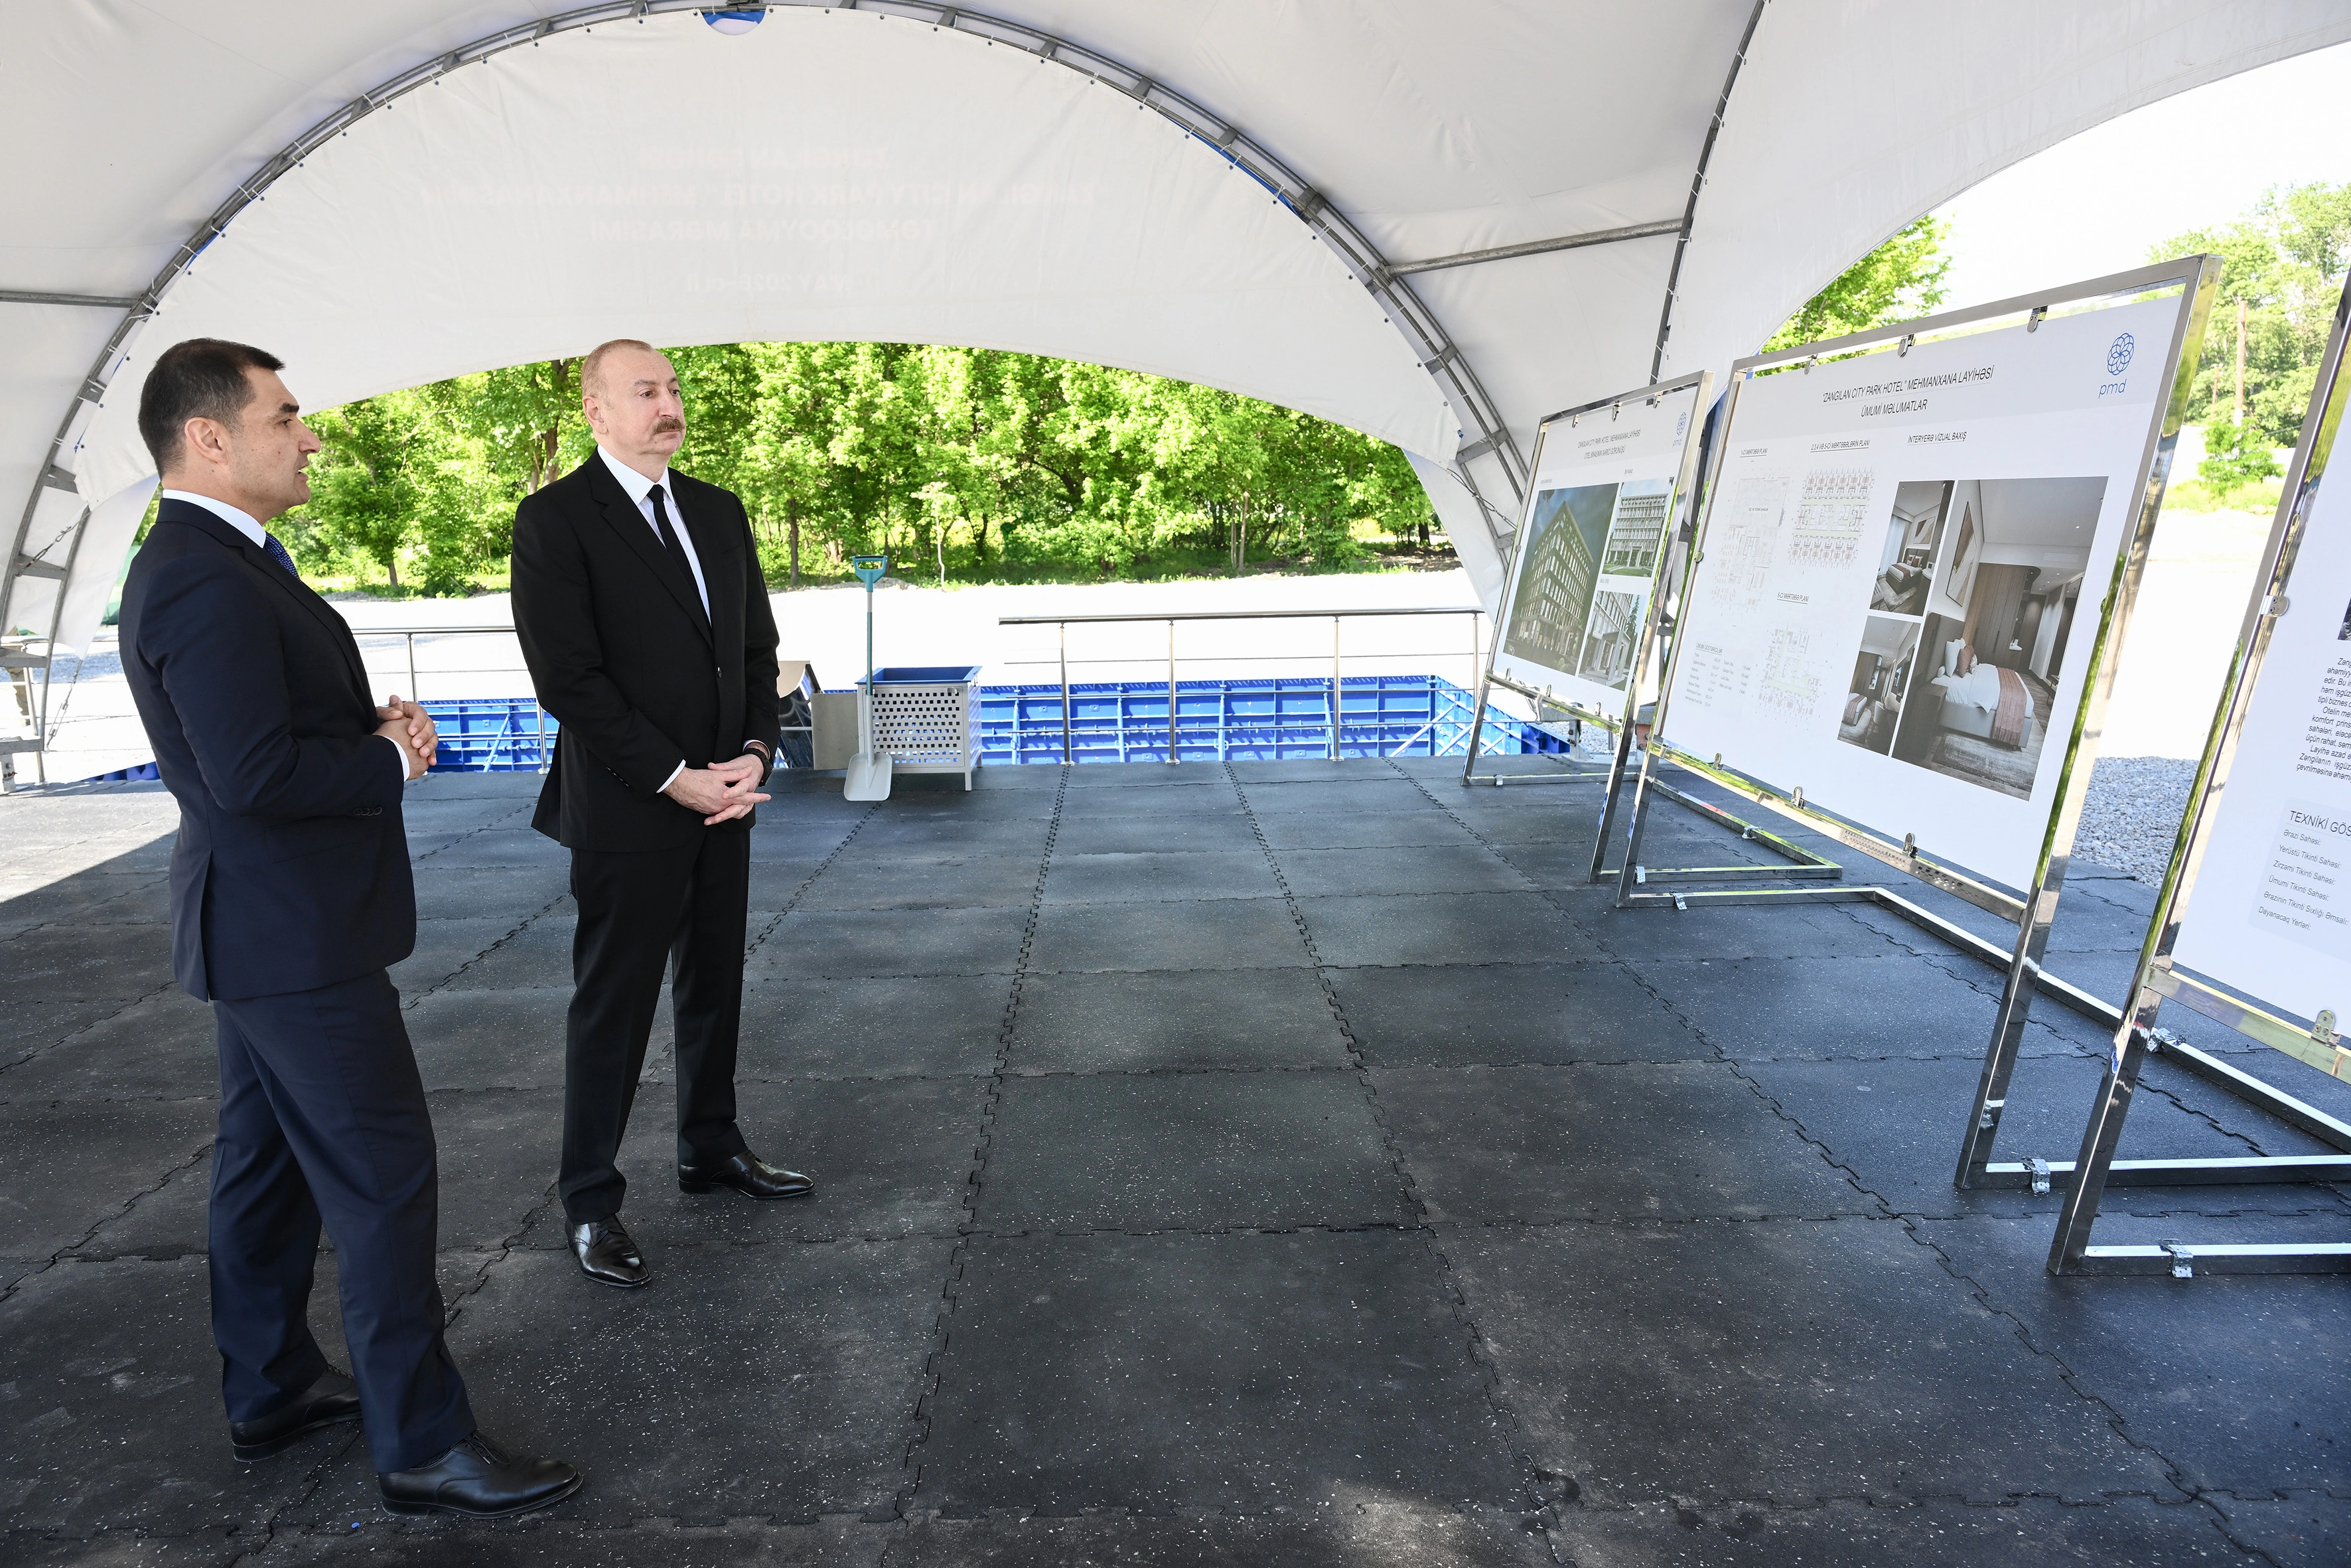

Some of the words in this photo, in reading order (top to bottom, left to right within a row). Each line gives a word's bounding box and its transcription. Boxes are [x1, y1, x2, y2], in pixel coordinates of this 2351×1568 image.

[1851, 386, 1865, 398] CITY
[1866, 384, 1883, 396] PARK
[1907, 372, 1957, 390] MEHMANXANA
[1958, 365, 1995, 383] LAYİHƏSİ
[2098, 378, 2127, 399] pmd
[1861, 401, 1882, 417] ÜMUMİ
[1883, 399, 1928, 415] MƏLUMATLAR
[1934, 433, 1951, 442] VİZUAL
[1952, 431, 1967, 441] BAXIŞ
[2318, 695, 2328, 704] tipli
[2328, 697, 2348, 707] biznes
[2312, 715, 2334, 725] komfort
[2322, 706, 2340, 716] Otelin
[2306, 735, 2320, 743] üçün
[2310, 745, 2330, 755] Layihə
[2331, 750, 2346, 759] azad
[2296, 763, 2332, 777] çevrilməsinə
[2299, 752, 2331, 766] Zəngilanın
[2334, 760, 2351, 771] işgüz
[2290, 810, 2329, 830] TEXNİKİ
[2330, 821, 2351, 837] GÖS
[2284, 829, 2299, 839] Ərazi
[2300, 833, 2322, 846] Sahəsi:
[2279, 845, 2300, 857] Yerüstü
[2301, 851, 2318, 862] Tikinti
[2319, 857, 2342, 869] Sahəsi:
[2273, 860, 2295, 873] Zirzəmi
[2296, 867, 2313, 878] Tikinti
[2313, 873, 2336, 885] Sahəsi:
[2269, 875, 2289, 887] Ümumi
[2290, 883, 2307, 894] Tikinti
[2307, 888, 2330, 901] Sahəsi:
[2263, 891, 2287, 905] Ərazinin
[2289, 898, 2305, 910] Tikinti
[2305, 905, 2324, 918] Sıxlığı
[2325, 912, 2349, 926] Əmsalı:
[2259, 906, 2291, 924] Dayanacaq
[2291, 917, 2312, 930] Yerləri:
